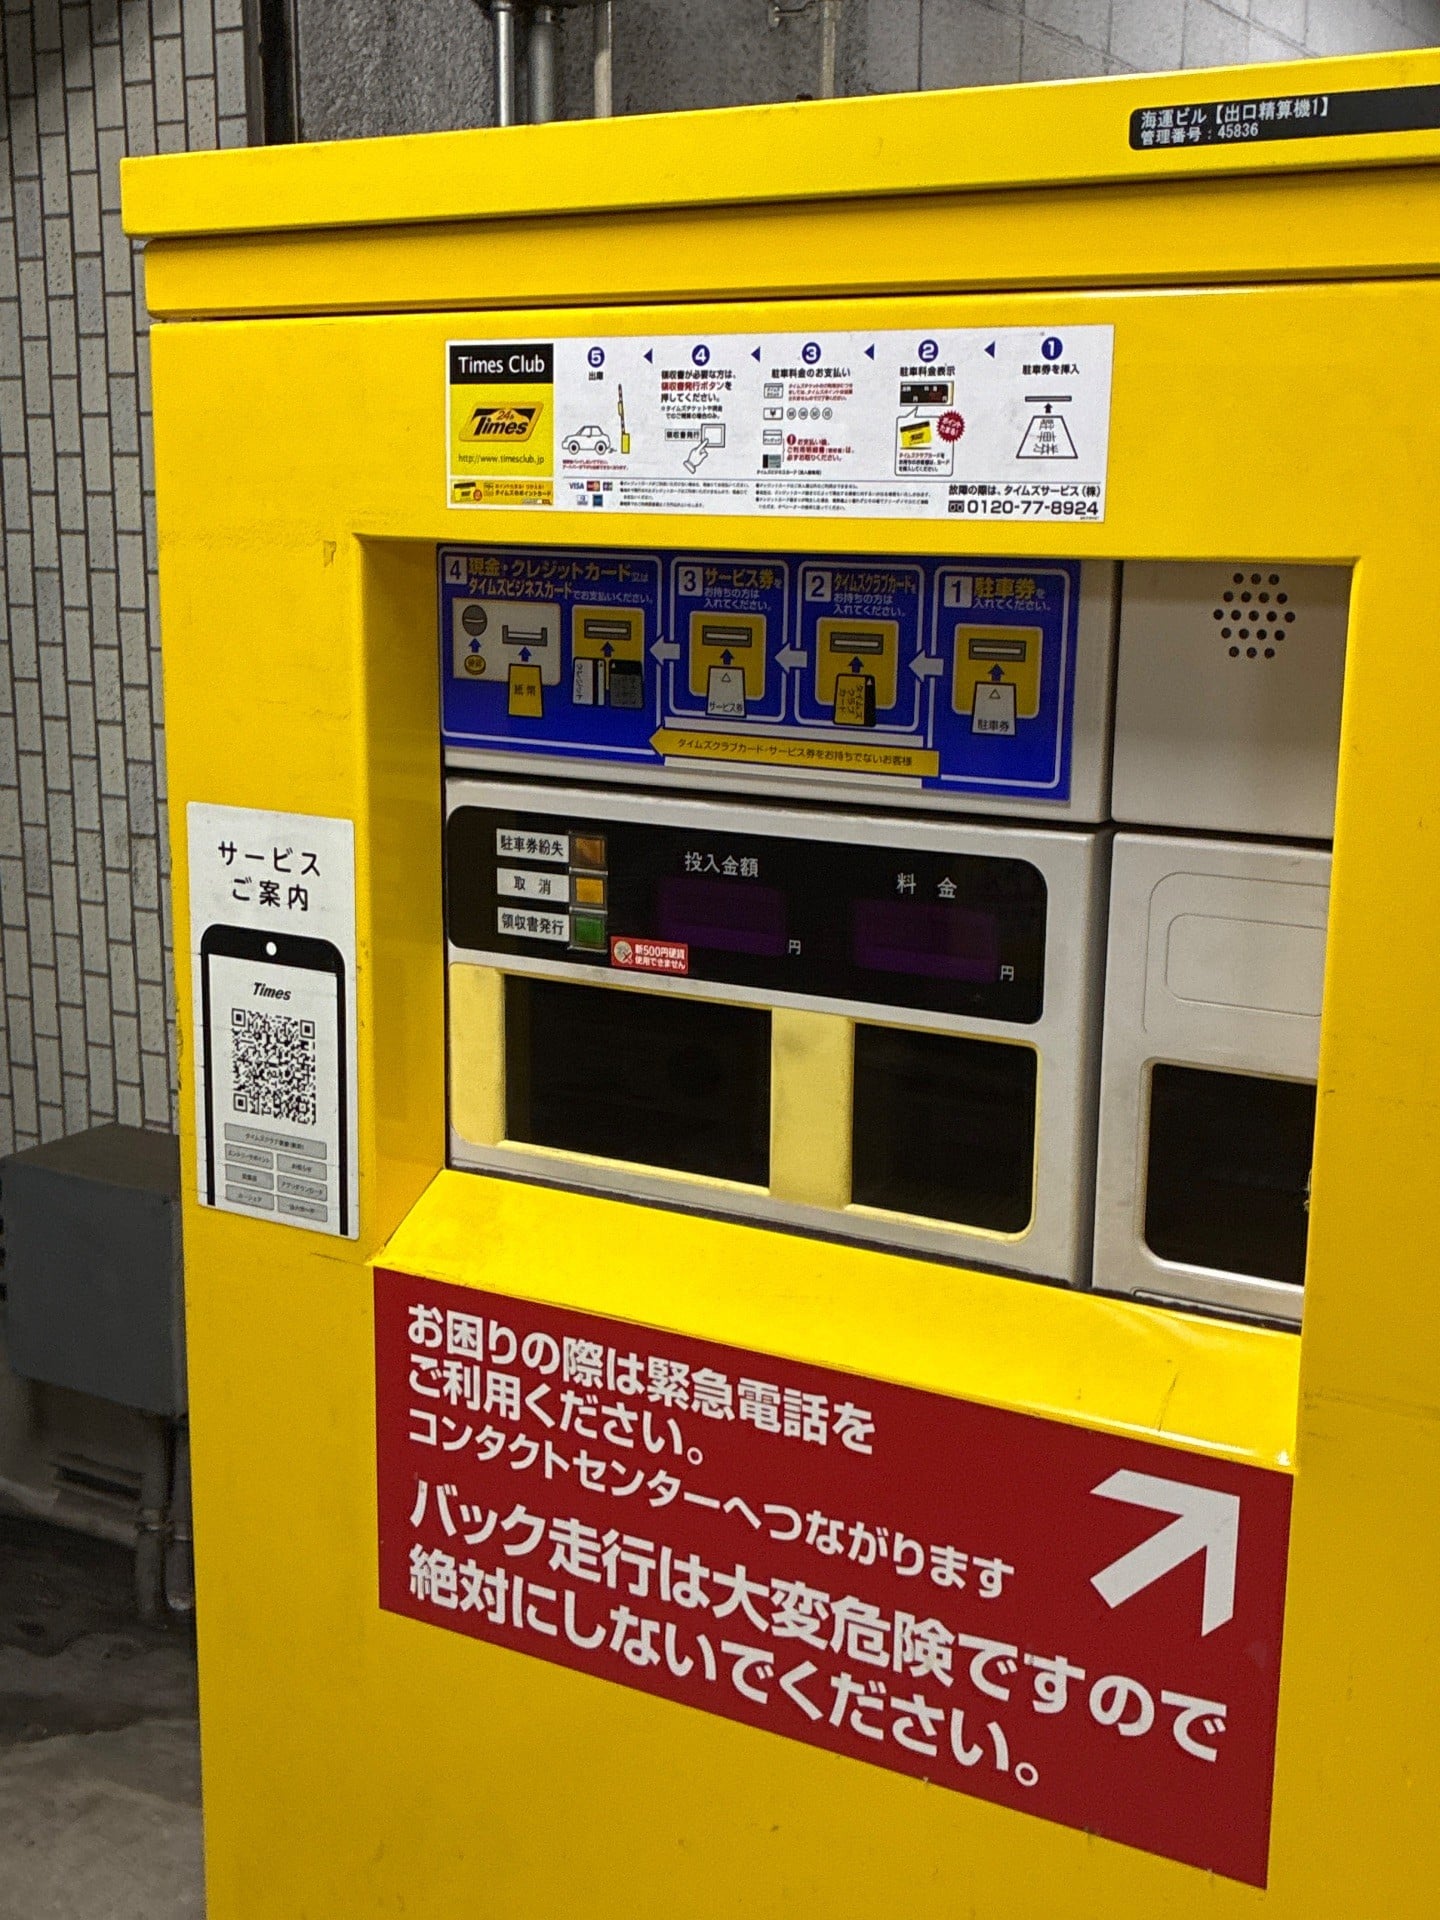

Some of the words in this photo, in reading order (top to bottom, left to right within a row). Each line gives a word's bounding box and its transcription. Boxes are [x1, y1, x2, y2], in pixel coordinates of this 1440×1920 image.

[457, 356, 503, 374] Times
[508, 354, 545, 373] Club
[899, 366, 956, 377] 駐車料金表示
[1022, 364, 1080, 375] 駐車券を挿入
[771, 368, 851, 379] 駐車料金のお支払い
[660, 393, 720, 403] 押してください。
[474, 415, 529, 436] Times
[457, 454, 545, 465] http://www.timesclub.jp
[967, 500, 1099, 517] 0120-77-8924
[704, 587, 760, 599] お持ちの方は
[834, 593, 893, 605] お持ちの方は
[704, 598, 772, 612] 入れてください。
[833, 603, 907, 618] 入れてください。
[972, 598, 1051, 612] 入れてください。
[977, 718, 1010, 733] 駐車券
[500, 835, 564, 857] 駐車券紛失
[218, 841, 320, 877] サービス
[684, 851, 759, 878] 投入金額
[232, 876, 309, 912] ご案内
[502, 913, 565, 936] 領収書発行
[788, 939, 802, 955] 円
[1000, 965, 1015, 982] 円
[253, 981, 292, 1001] Times
[407, 1303, 876, 1455] お困りの際は緊急電話を
[408, 1353, 704, 1466] ご利用ください。
[408, 1408, 1015, 1600] コンタクトセンターへつながります
[409, 1479, 1227, 1764] バック走行は大変危険ですので
[408, 1543, 1040, 1787] 絶対にしないでください。
